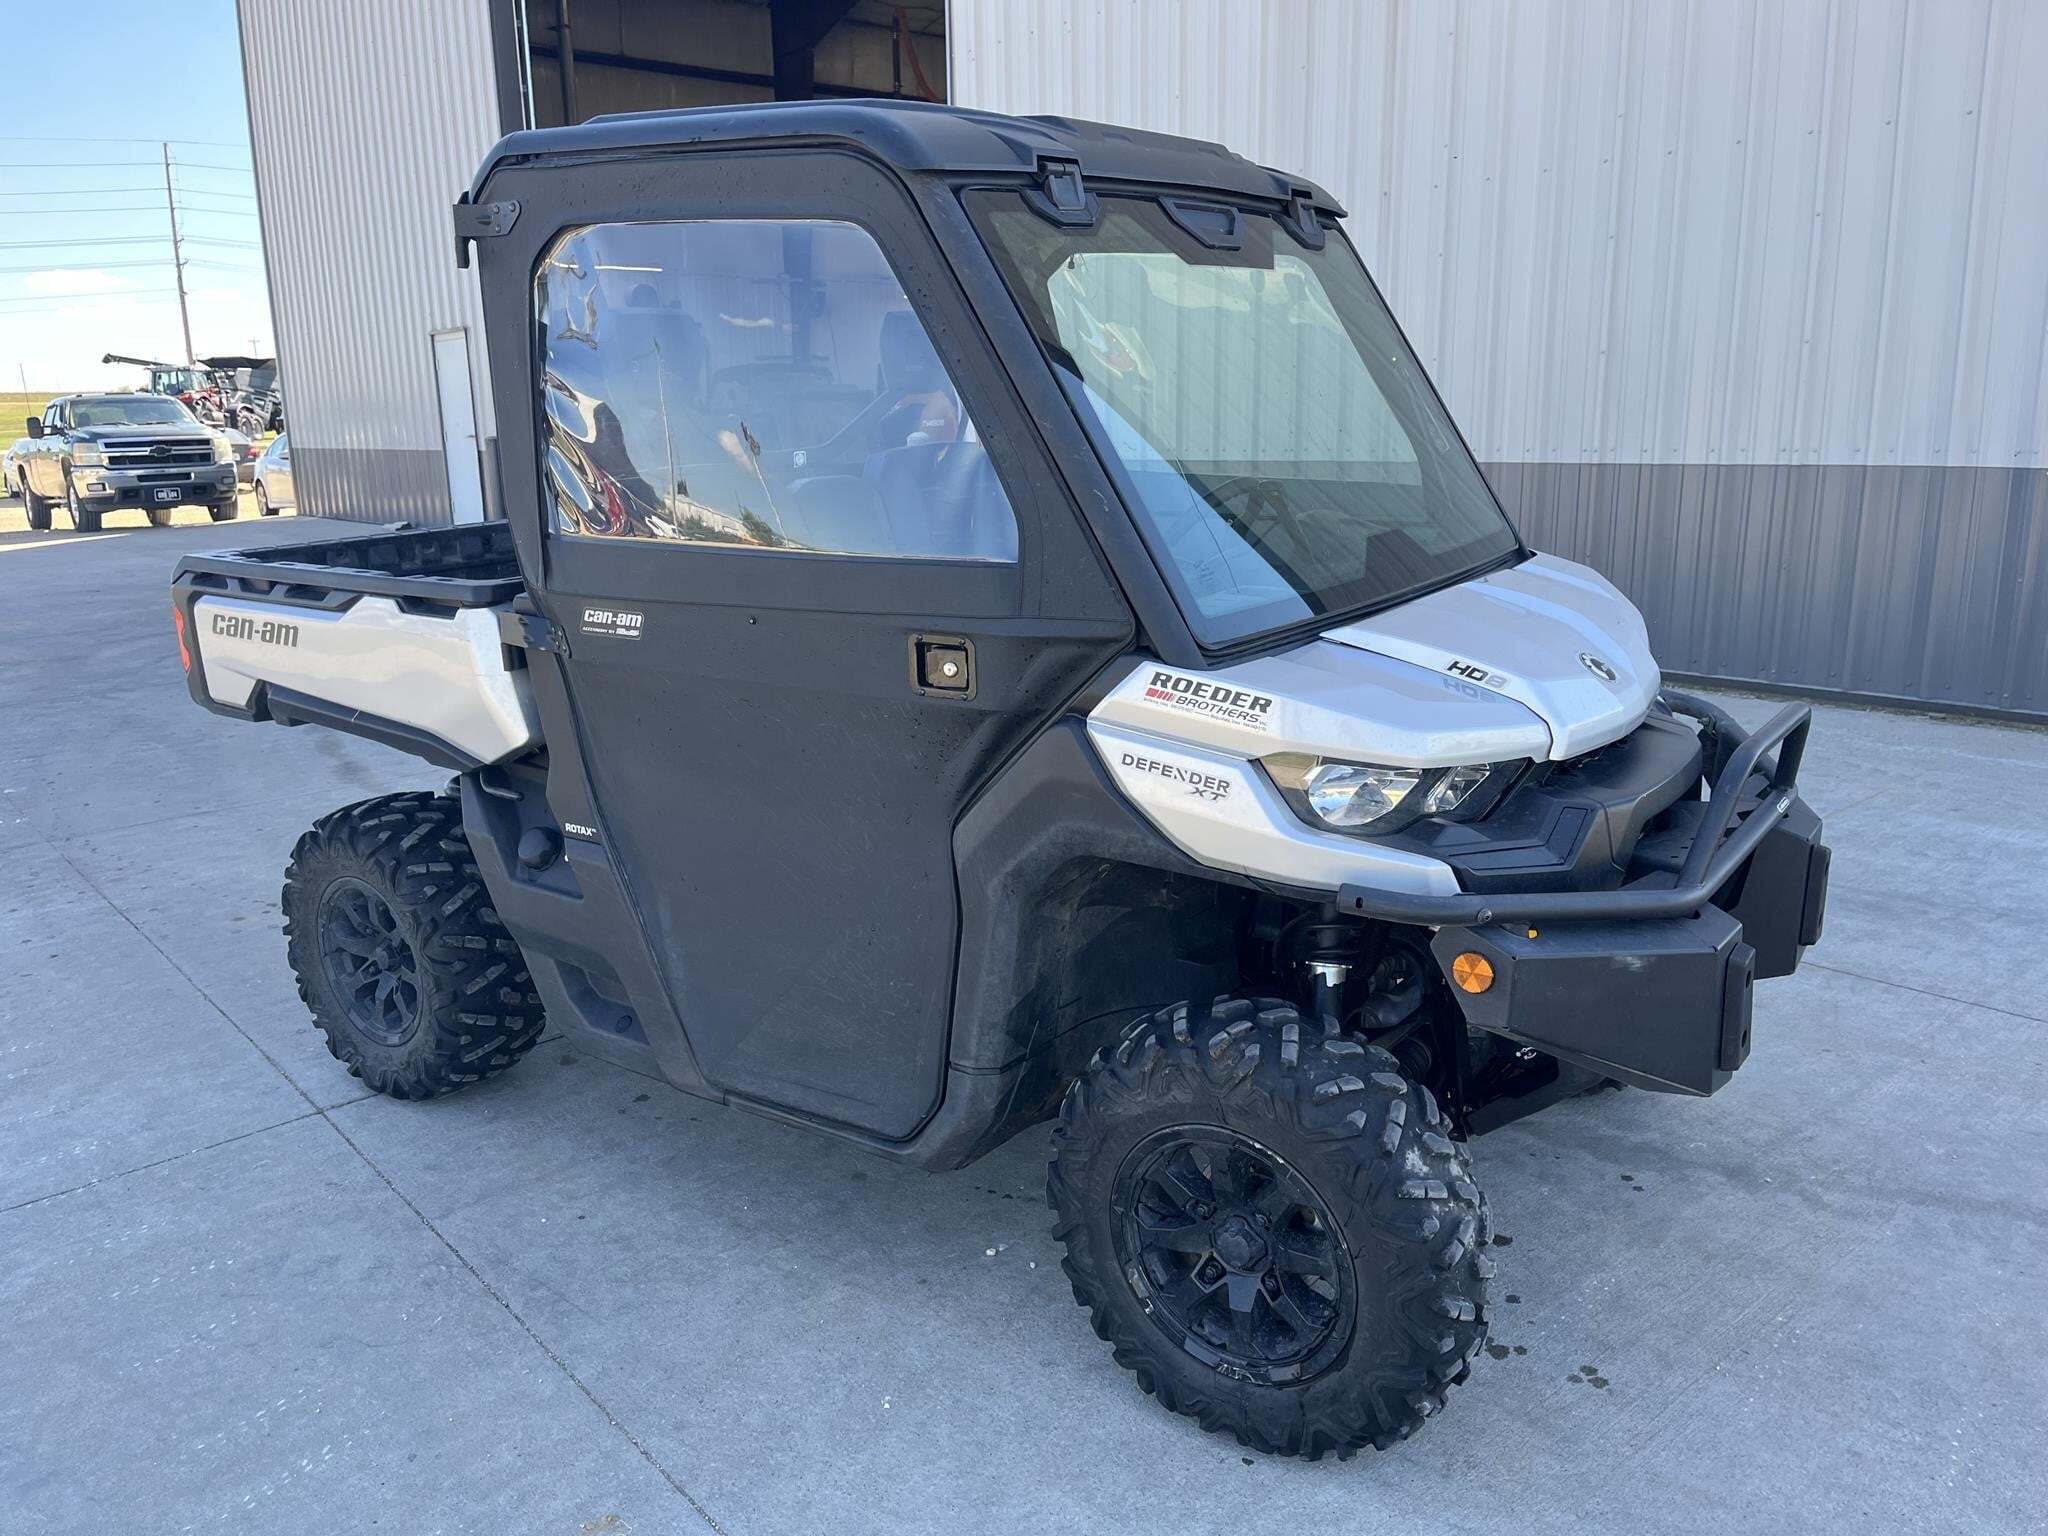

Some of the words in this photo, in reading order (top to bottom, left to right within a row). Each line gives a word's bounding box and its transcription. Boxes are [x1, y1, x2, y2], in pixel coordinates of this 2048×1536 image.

[212, 613, 299, 648] can-am
[584, 609, 642, 628] can-am
[1446, 660, 1509, 690] HD8
[1149, 671, 1272, 714] ROEDER
[1175, 695, 1261, 723] BROTHERS
[1121, 753, 1231, 794] DEFENDER
[1189, 786, 1227, 801] XT
[565, 822, 593, 837] ROTAX
